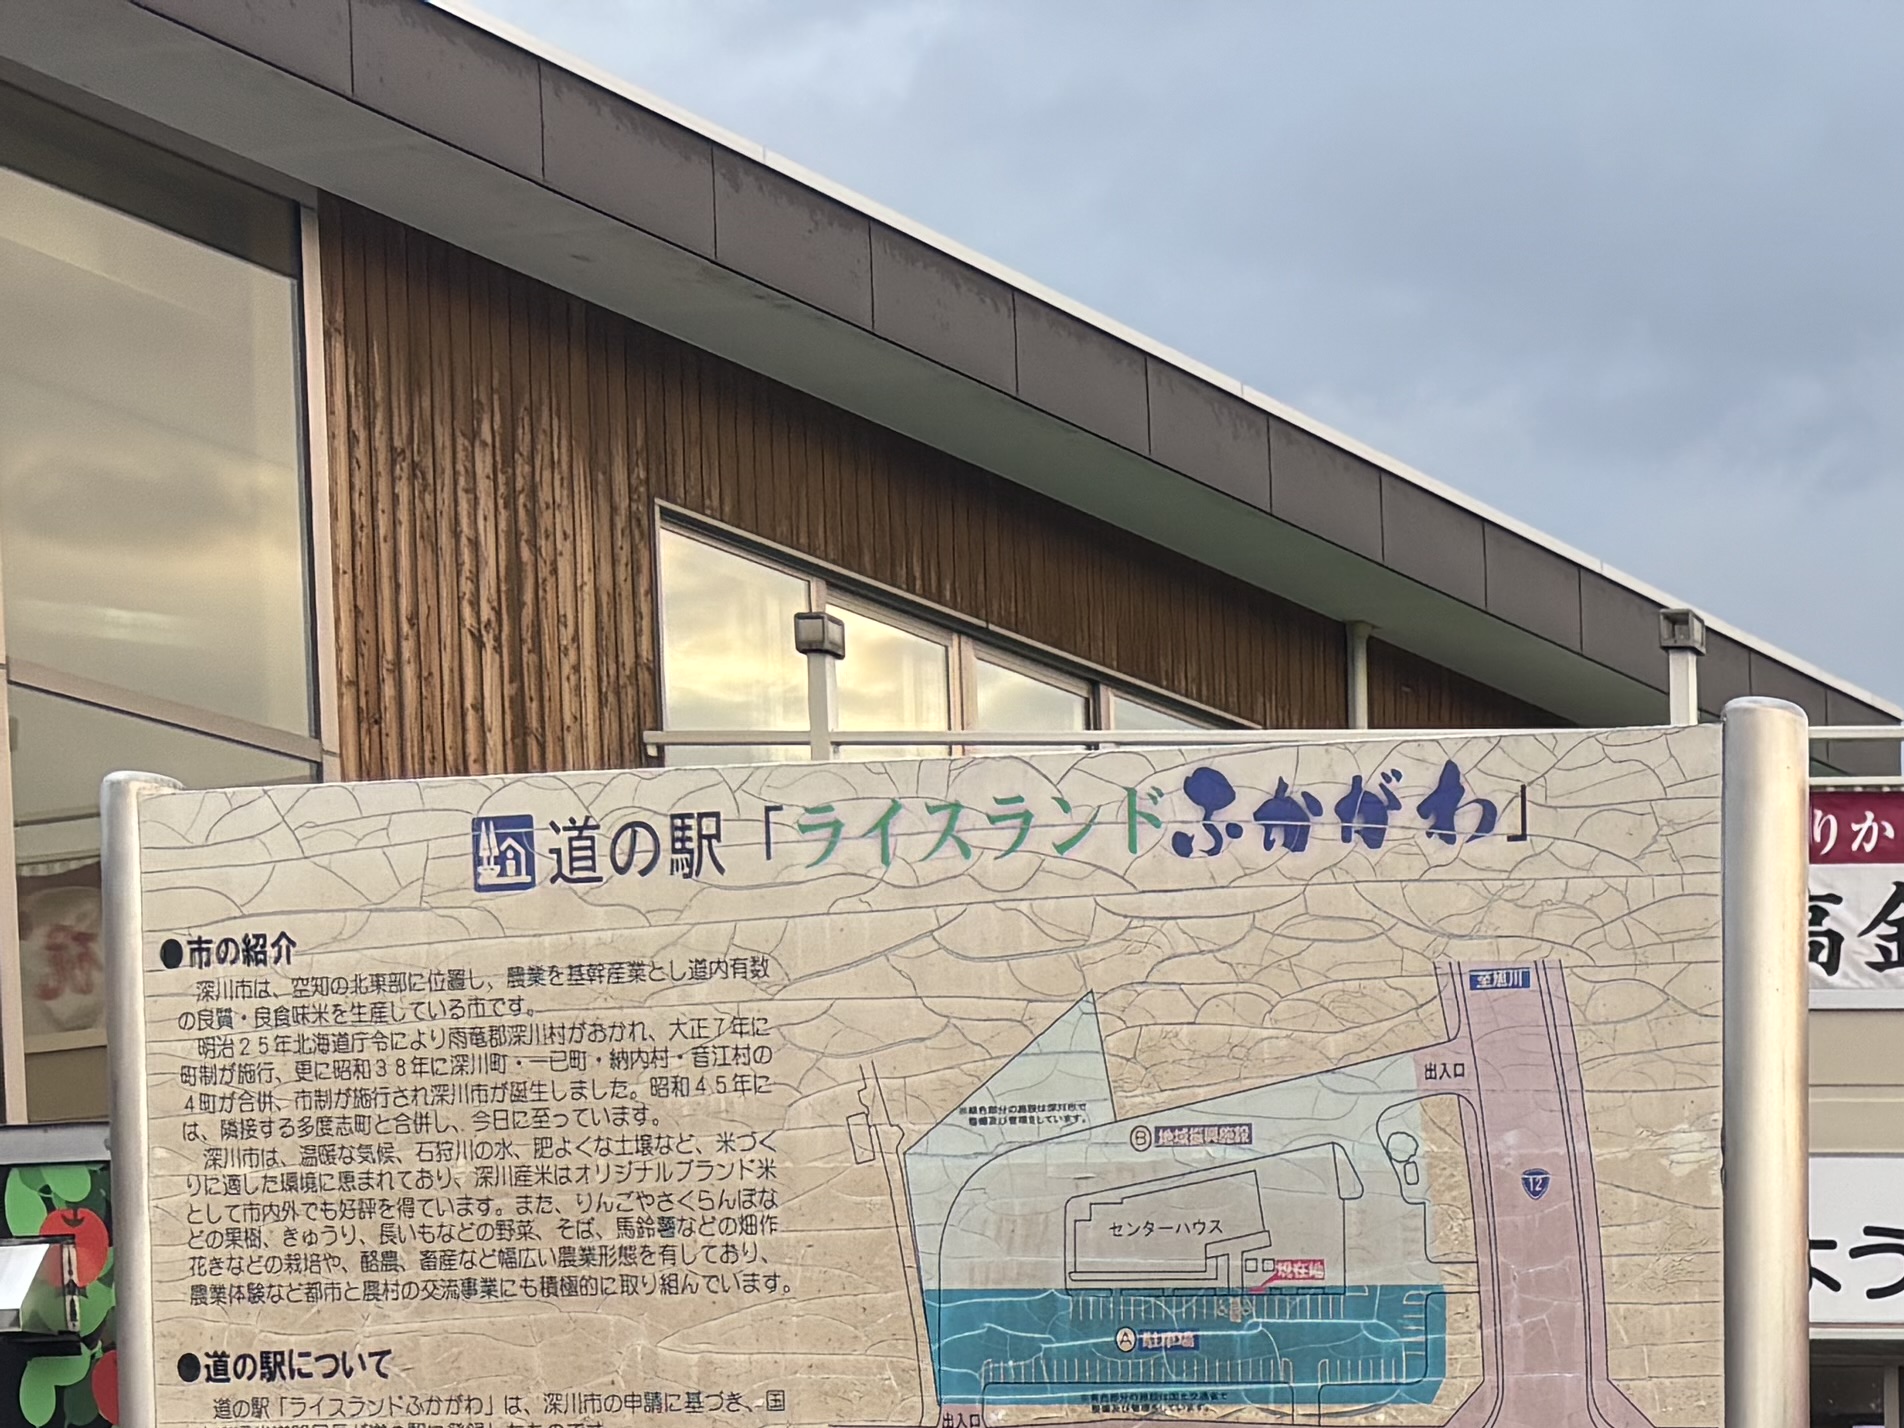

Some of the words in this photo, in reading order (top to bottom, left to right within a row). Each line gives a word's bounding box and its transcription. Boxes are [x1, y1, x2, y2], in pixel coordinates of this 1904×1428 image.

[185, 932, 299, 968] 市の紹介
[1473, 969, 1524, 990] 至旭川
[1423, 1061, 1467, 1082] 出入口
[1109, 1220, 1223, 1237] センターハウス
[204, 1349, 393, 1383] 道の駅について
